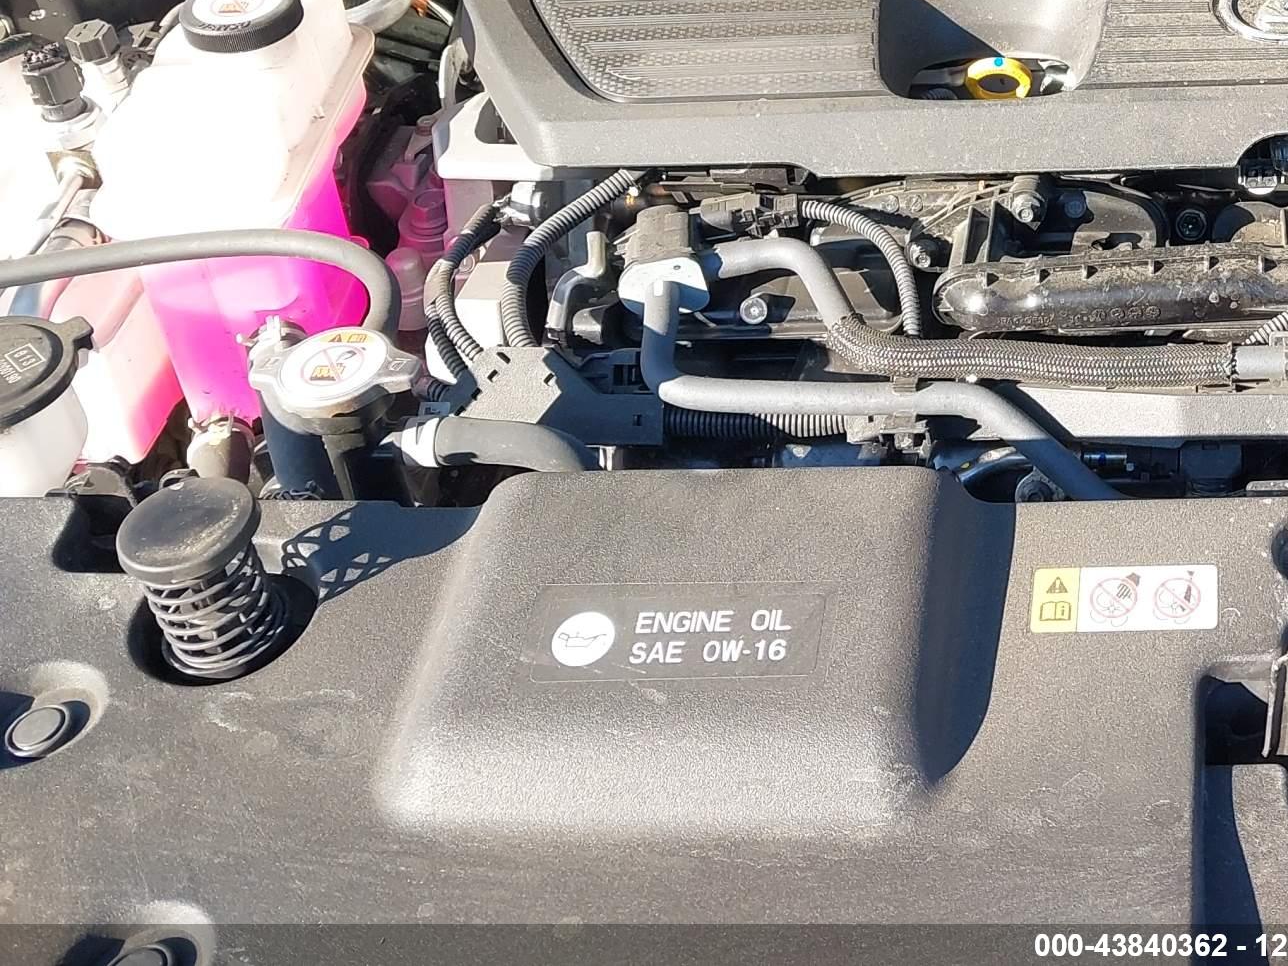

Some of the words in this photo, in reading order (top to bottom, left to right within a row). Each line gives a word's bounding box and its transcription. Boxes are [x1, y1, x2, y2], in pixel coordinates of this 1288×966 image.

[635, 610, 735, 634] ENGINE
[750, 609, 792, 632] OIL
[628, 641, 686, 664] SAE
[702, 639, 787, 662] 0W-16
